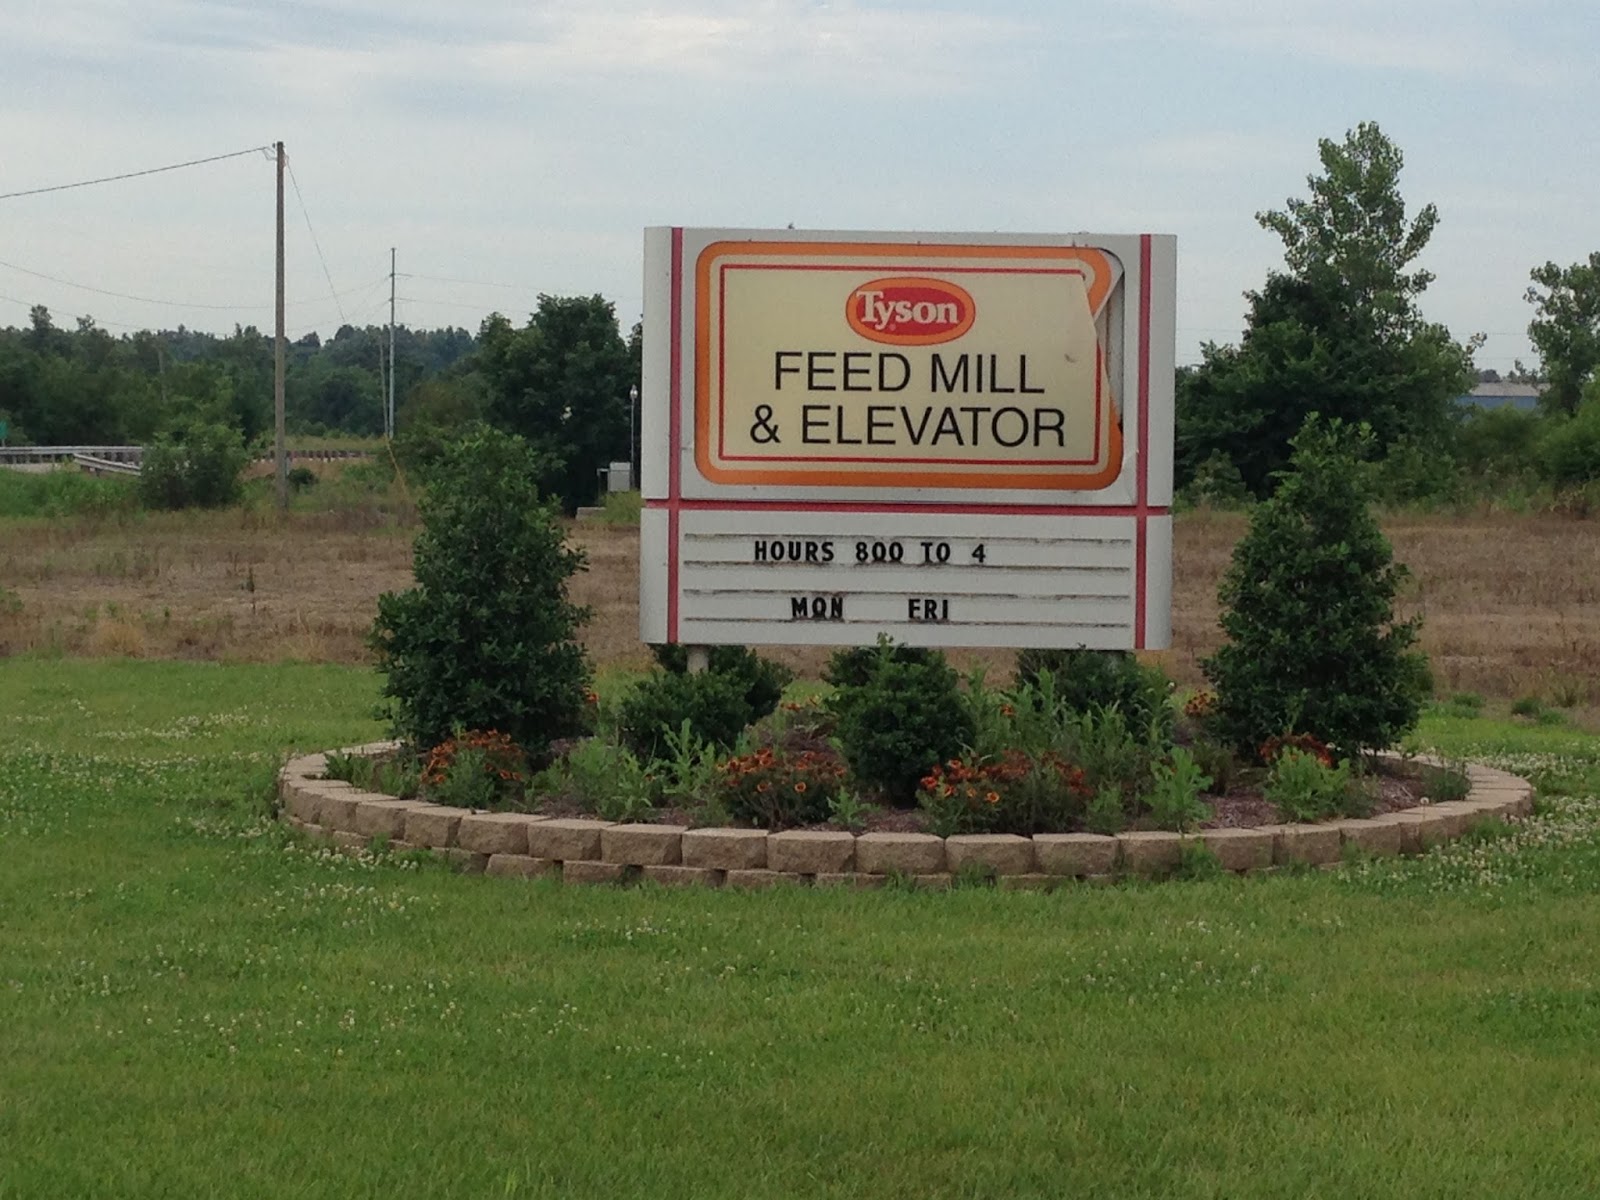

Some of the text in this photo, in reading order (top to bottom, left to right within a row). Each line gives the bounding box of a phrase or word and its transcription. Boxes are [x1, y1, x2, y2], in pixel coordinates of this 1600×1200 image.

[855, 289, 960, 332] Tyson
[774, 351, 1046, 395] FEED MILL
[749, 403, 1066, 447] & ELEVATOR
[754, 540, 987, 564] HOURS 800 TO 4
[791, 597, 844, 620] MON
